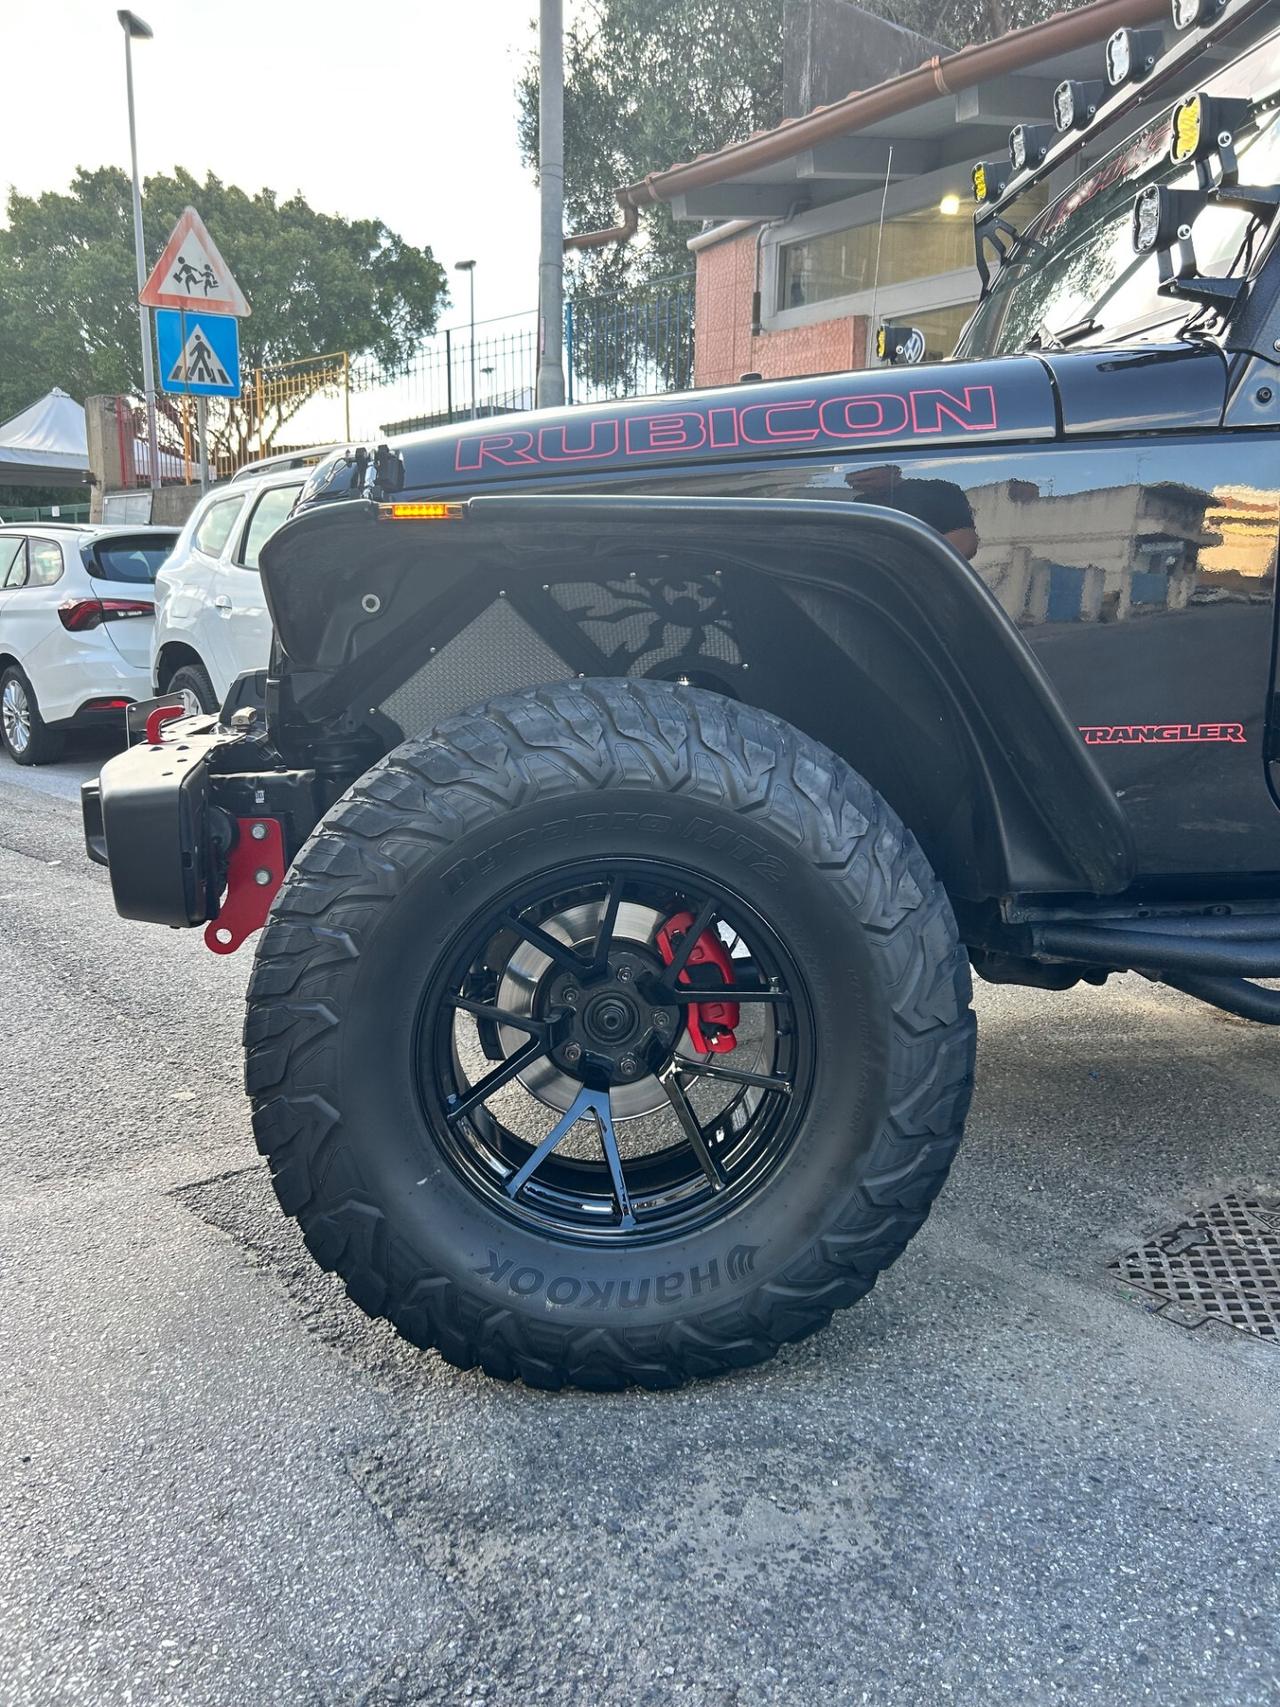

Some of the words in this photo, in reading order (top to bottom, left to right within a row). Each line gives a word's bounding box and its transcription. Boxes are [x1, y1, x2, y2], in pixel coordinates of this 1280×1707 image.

[455, 386, 998, 472] RUBICON
[1078, 723, 1248, 744] RANGLER
[680, 816, 791, 883] MT2
